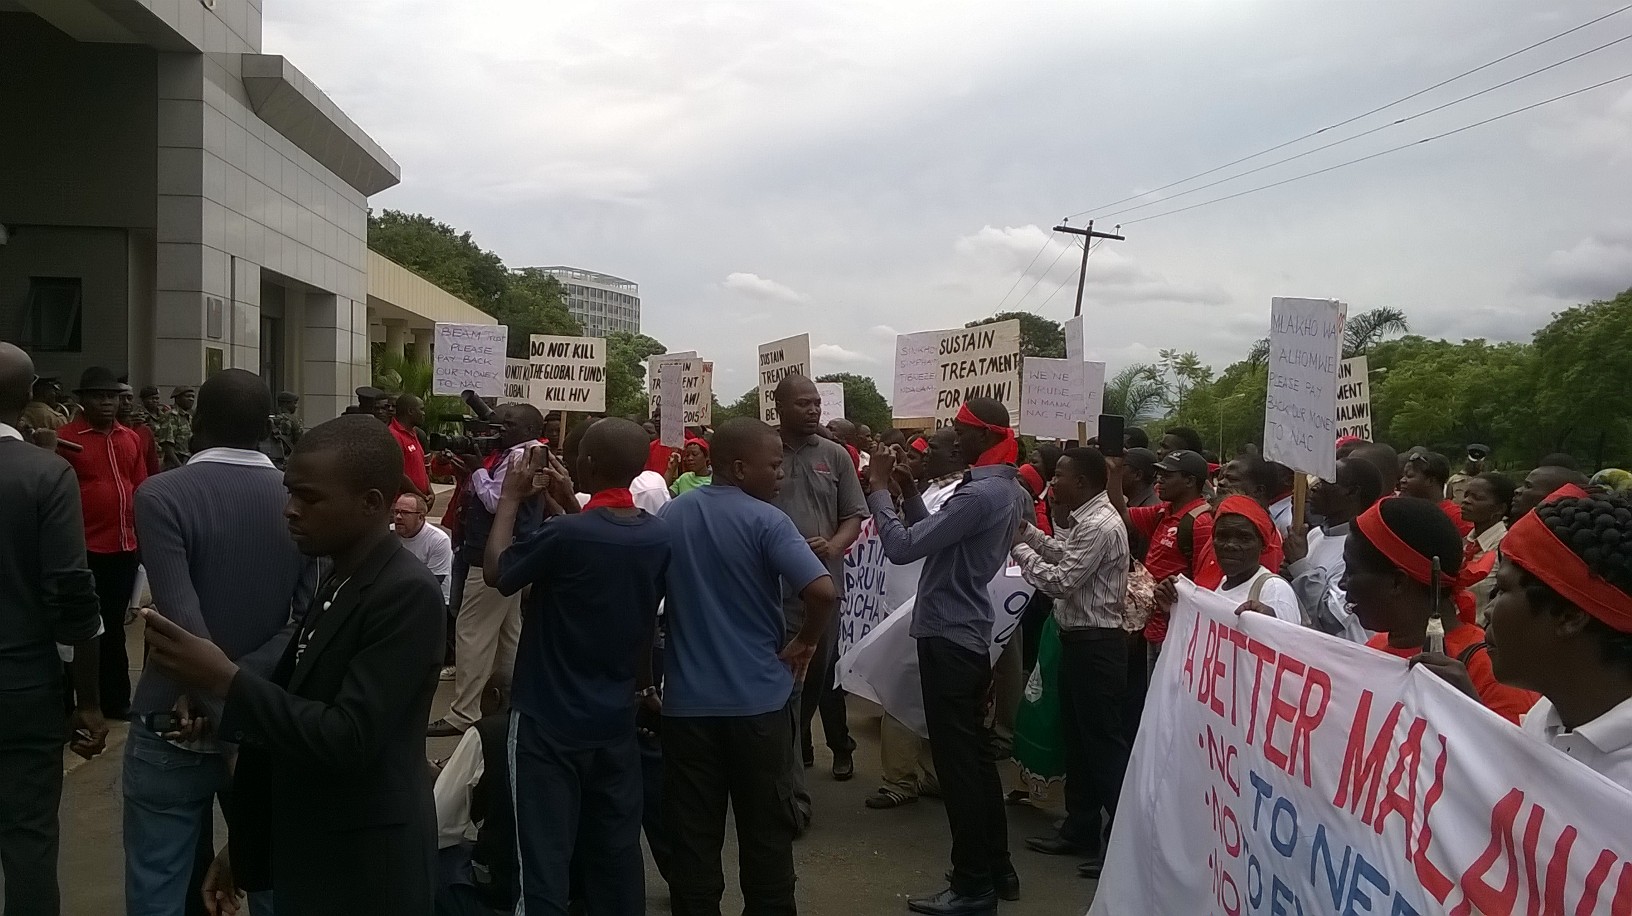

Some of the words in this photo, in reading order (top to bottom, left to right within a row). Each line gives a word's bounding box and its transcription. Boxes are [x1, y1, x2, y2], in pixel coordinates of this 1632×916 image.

[441, 327, 481, 340] BEAM
[1273, 314, 1318, 337] MLAKHO
[1323, 321, 1336, 339] WA
[451, 343, 492, 354] PLEASE
[530, 340, 545, 356] DO
[547, 342, 570, 358] NOT
[572, 343, 595, 359] KILL
[939, 330, 995, 355] SUSTAIN
[437, 354, 455, 362] PAY
[462, 355, 492, 365] BACK
[760, 348, 785, 366] SUSTAIN
[941, 353, 1018, 381] TREATMENT
[1279, 348, 1334, 374] ALHOMWE
[437, 368, 457, 376] OUR
[464, 369, 498, 379] MONEY
[530, 363, 544, 380] THE
[543, 364, 575, 380] GLOBAL
[578, 365, 605, 382] FUND!
[1029, 371, 1048, 380] WE
[437, 378, 452, 388] TO
[460, 380, 482, 388] NAC
[1269, 372, 1300, 392] PLEASE
[1305, 382, 1323, 399] PAY
[545, 386, 566, 401] KILL
[569, 387, 590, 402] HIV
[937, 388, 961, 410] FOR
[684, 410, 699, 423] 2015
[1026, 410, 1048, 418] NAC
[1267, 394, 1289, 416] BACK
[1292, 403, 1306, 421] OUR
[1309, 409, 1334, 432] MONEY
[1269, 421, 1284, 441] TO
[1291, 429, 1314, 452] NAC
[1183, 611, 1200, 693] A
[1197, 618, 1332, 788] BETTER
[1211, 785, 1240, 858] NO
[1249, 770, 1298, 858] TO
[1212, 848, 1241, 916] NO
